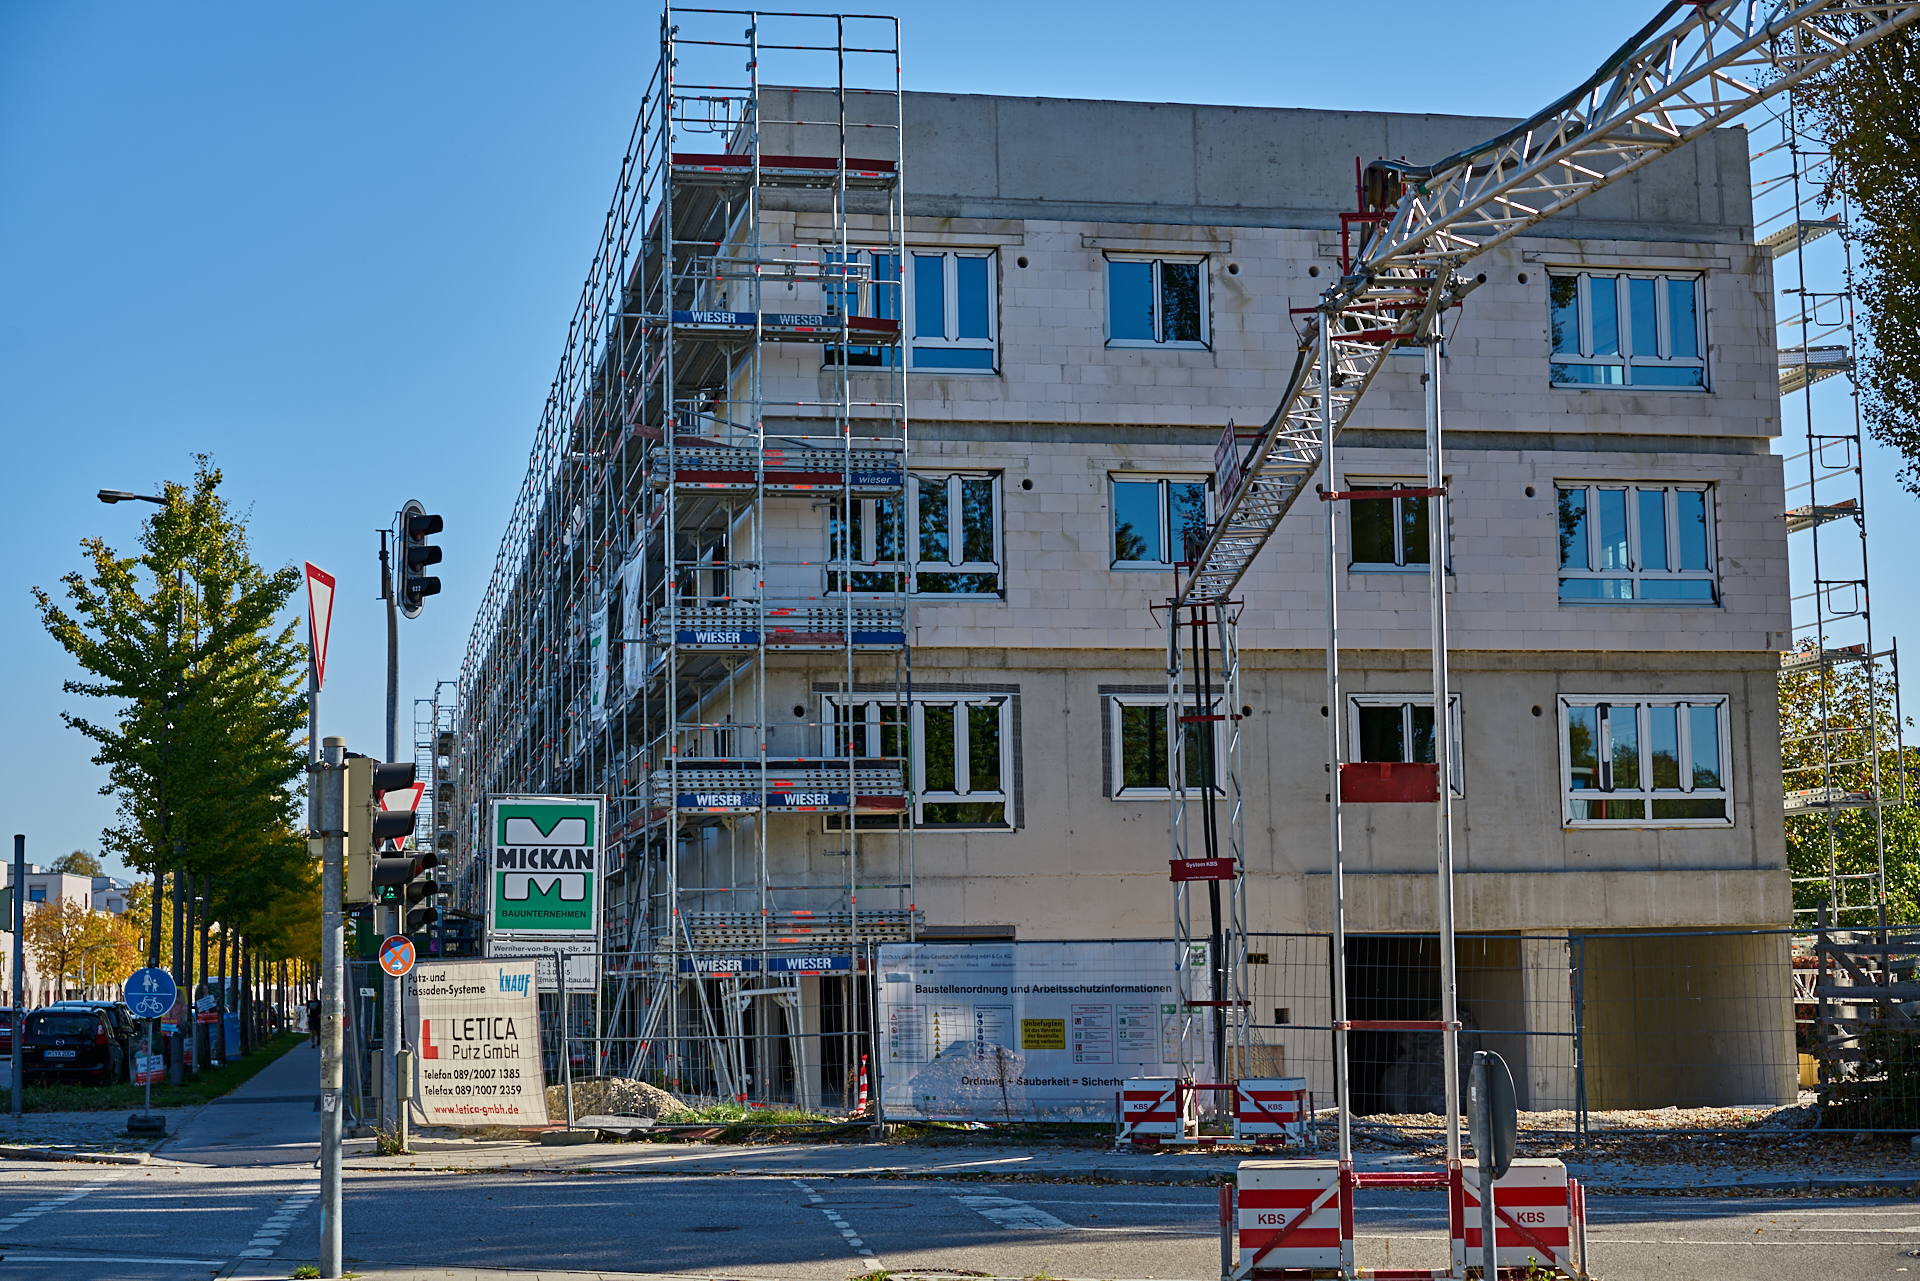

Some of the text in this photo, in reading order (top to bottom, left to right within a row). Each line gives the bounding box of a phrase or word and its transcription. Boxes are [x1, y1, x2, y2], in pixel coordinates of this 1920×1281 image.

[692, 311, 736, 323] WIESER
[780, 314, 823, 326] WIESER
[859, 474, 892, 484] wieser
[696, 632, 740, 644] WIESER
[696, 794, 742, 806] WIESER
[784, 794, 829, 806] WIESER
[496, 848, 594, 870] MICKAN
[502, 910, 587, 918] BAUUNTERNEHMEN
[697, 960, 742, 972] WIESER
[786, 958, 832, 970] WIESER
[499, 968, 531, 998] KNAUF
[408, 984, 486, 997] Fassaden-Systeme
[915, 984, 1172, 995] Baustellenordnung und Arbeitsschutzinformationen
[452, 1017, 518, 1040] LETICA
[452, 1044, 520, 1060] Putz GmbH
[424, 1068, 520, 1080] Telefon 089/2007 1385
[961, 1077, 1004, 1087] Ordnung
[1016, 1077, 1070, 1086] Sauberkeit
[1081, 1077, 1124, 1086] Sicherhe
[424, 1085, 522, 1096] Telefax 089/2007 2359
[434, 1104, 519, 1116] www.letica-gmbh.de
[1258, 1214, 1286, 1224] KBS
[1517, 1212, 1545, 1223] KBS
